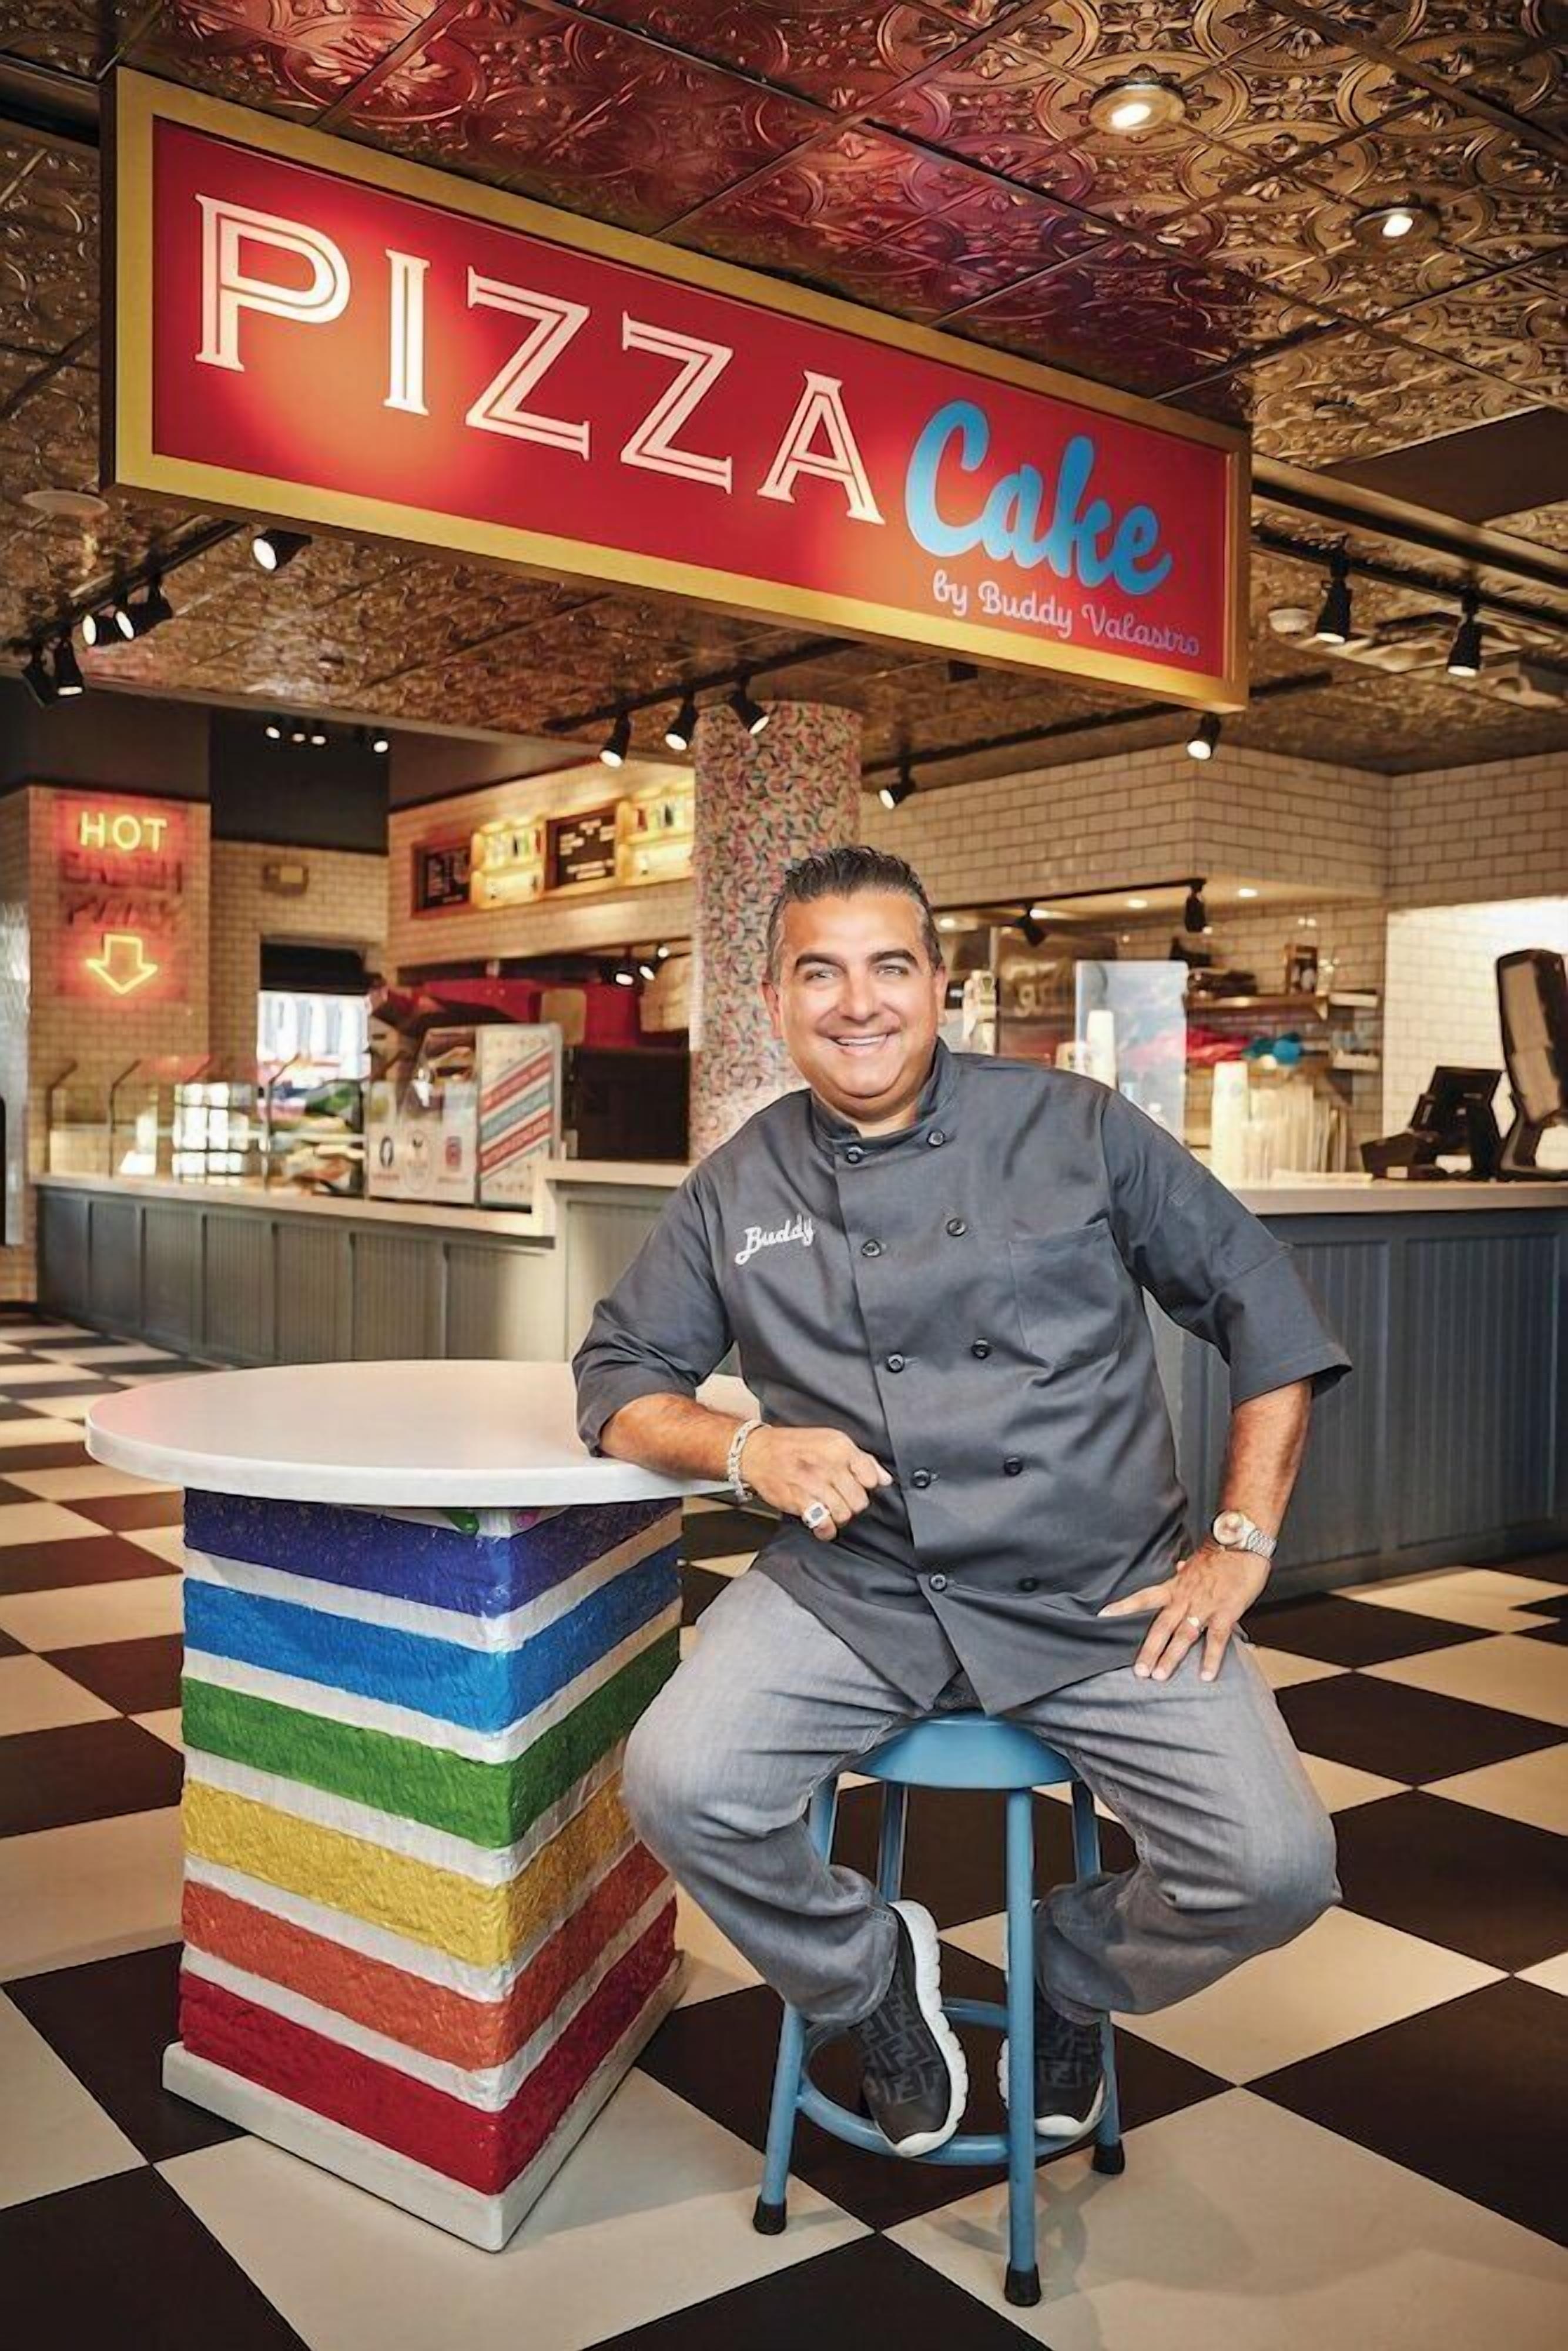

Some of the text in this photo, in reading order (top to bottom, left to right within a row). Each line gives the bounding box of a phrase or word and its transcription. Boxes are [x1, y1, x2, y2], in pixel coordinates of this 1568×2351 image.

[195, 194, 1172, 595] PIZZA Cake
[932, 568, 1201, 657] by Buddy Valastro
[81, 812, 167, 852] HOT
[735, 1214, 815, 1265] Buddy
